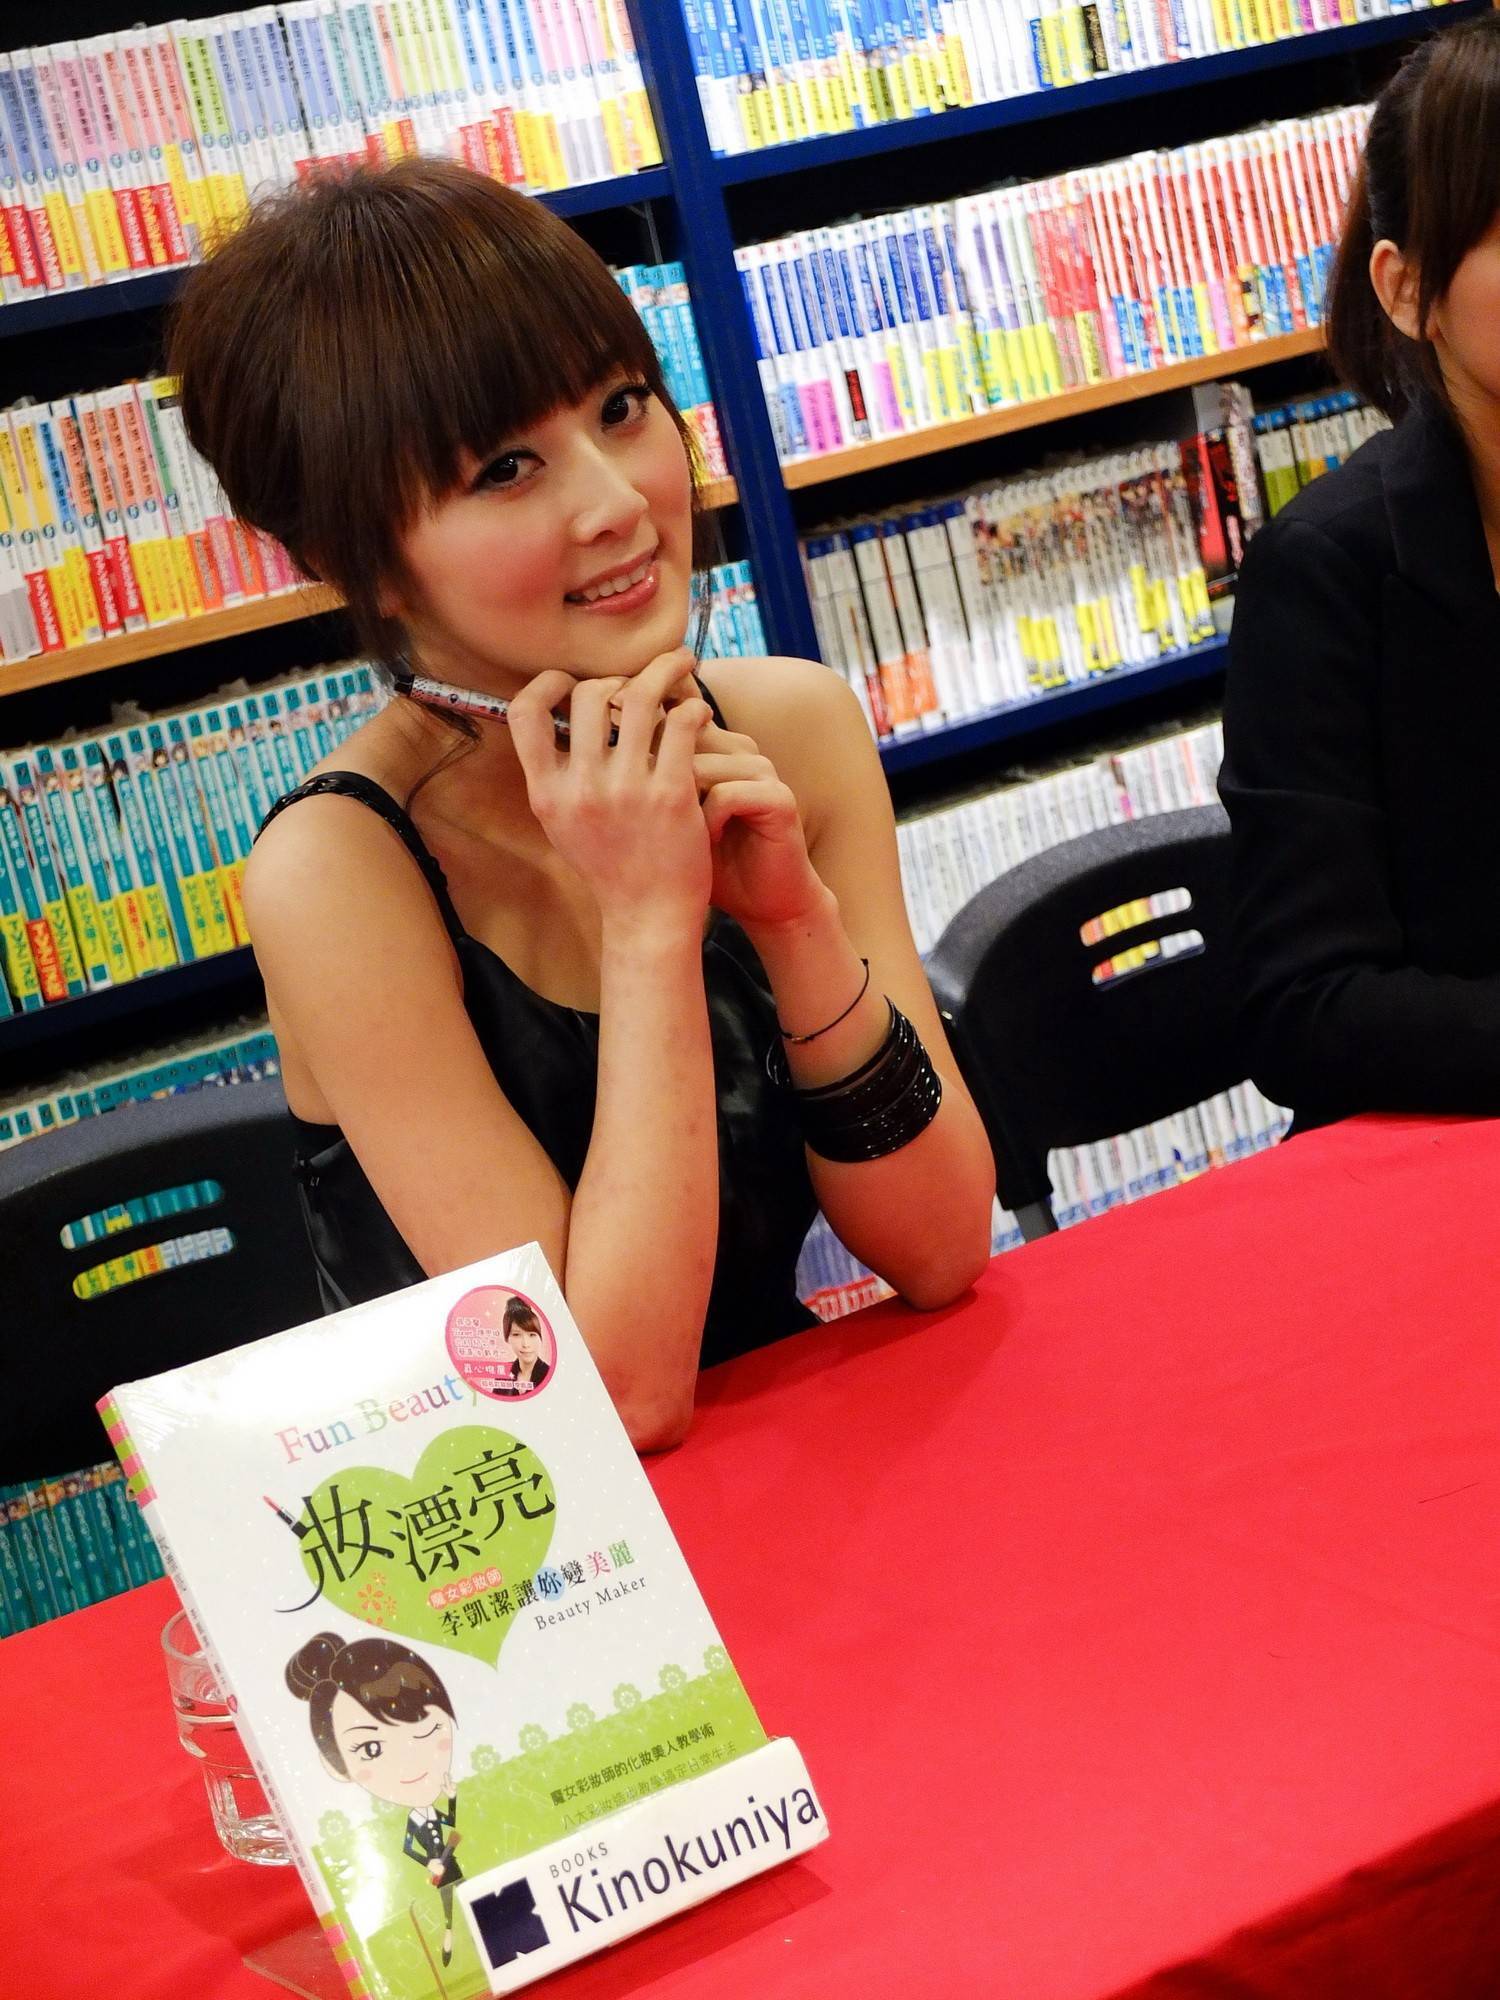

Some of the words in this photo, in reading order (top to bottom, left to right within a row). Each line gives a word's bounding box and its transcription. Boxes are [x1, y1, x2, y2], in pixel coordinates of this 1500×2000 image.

[274, 1420, 356, 1464] Fun
[274, 1443, 556, 1613] 妝漂亮
[534, 1600, 593, 1631] Beauty
[595, 1576, 648, 1606] Maker
[549, 1842, 609, 1878] BOOKS
[557, 1787, 819, 1933] Kinokuniya
